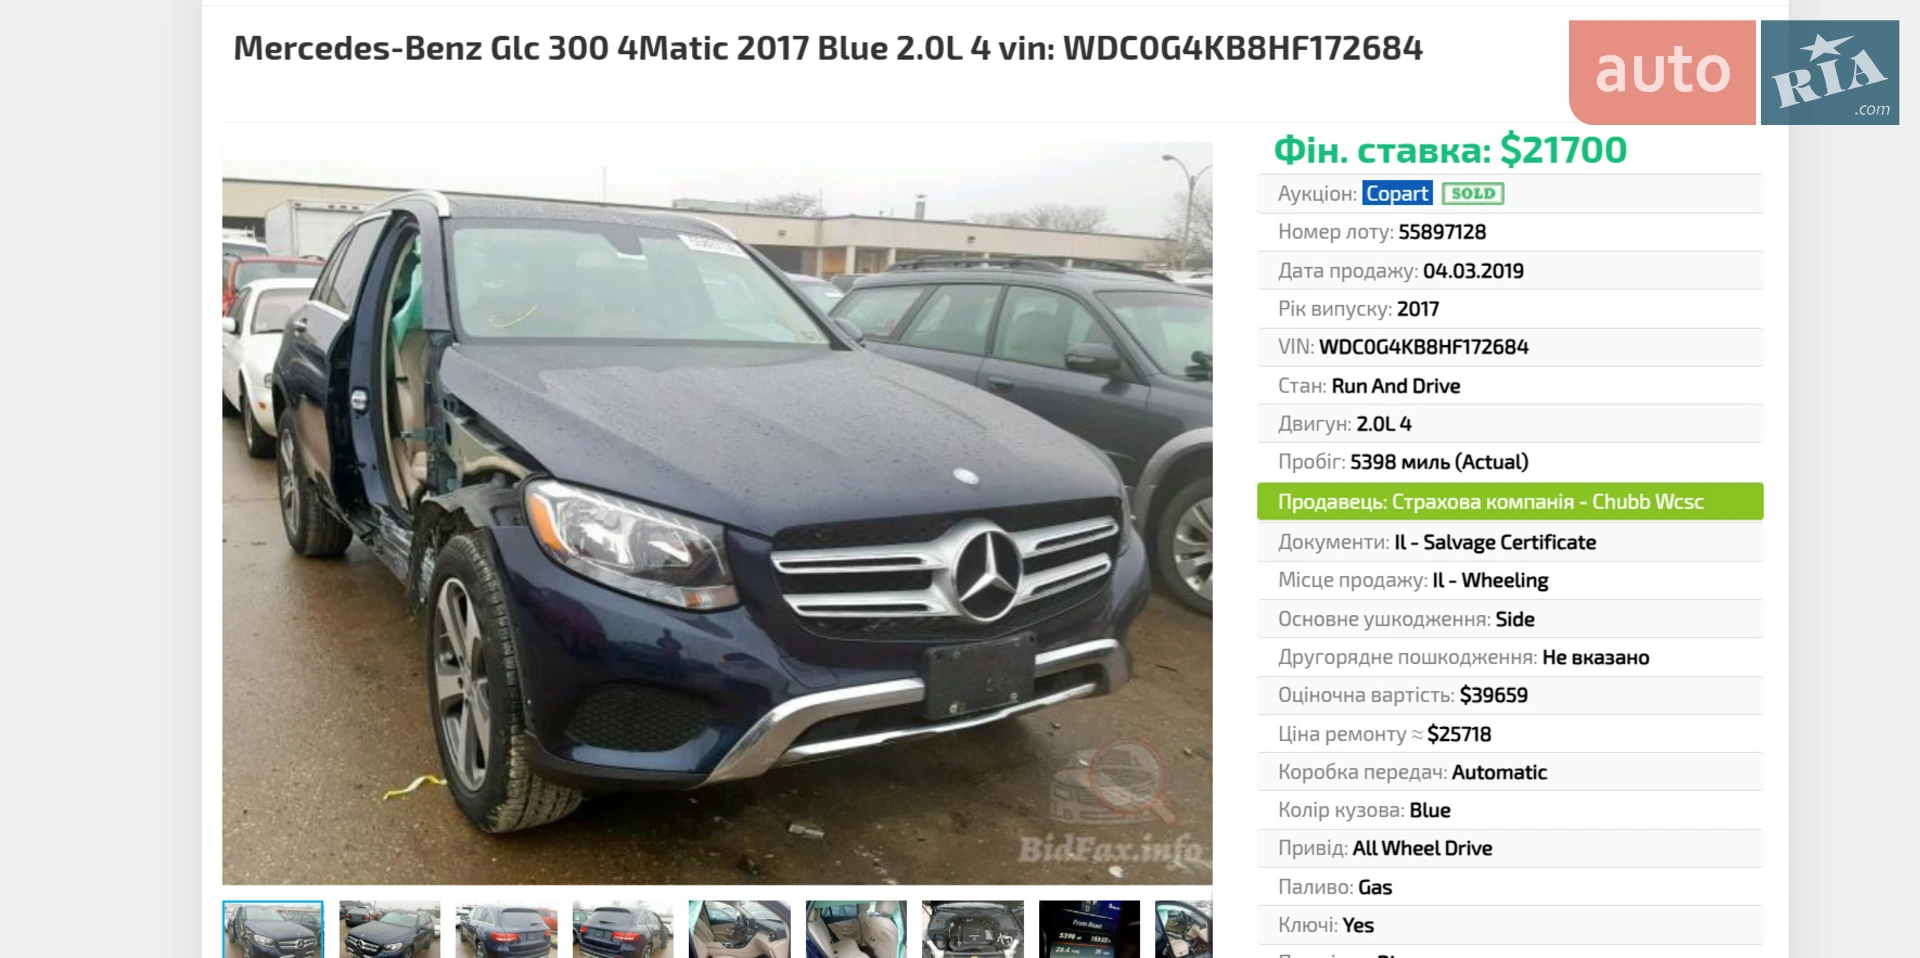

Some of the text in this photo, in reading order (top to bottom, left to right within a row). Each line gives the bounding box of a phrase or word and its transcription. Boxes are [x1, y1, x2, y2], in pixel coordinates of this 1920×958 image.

[235, 35, 1423, 60] Mercedes-Benz Glc 300 4Matic 2017 Blue 2.0L 4 vin: WDC0G4KB8HF172684
[1274, 130, 1627, 169] Фін. ставка: $21700
[1279, 184, 1496, 206] Аукціон: Copart SOLD
[1280, 223, 1486, 243] Номер лоту: 55897128
[1279, 262, 1524, 282] Дата продажу: 04.03.2019
[1280, 300, 1440, 320] Рік випуску: 2017
[1279, 338, 1529, 355] VIN: WDC0G4KB8HF172684
[1279, 377, 1461, 394] Стан: Run And Drive
[1279, 415, 1412, 435] Двигун: 2.0L 4
[1280, 452, 1529, 473] Пробіг: 5398 миль (Actual)
[1279, 493, 1387, 513] Продавець:
[1392, 493, 1481, 514] Страхова
[1487, 493, 1574, 509] компанія
[1592, 493, 1651, 509] Chubb
[1655, 493, 1704, 509] Wcsc
[1279, 534, 1389, 554] Документи:
[1424, 534, 1496, 554] Salvage
[1501, 534, 1596, 550] Certificate
[1280, 572, 1334, 590] Місце
[1340, 576, 1427, 592] продажу:
[1461, 572, 1549, 592] Wheeling
[1279, 611, 1535, 631] Основне ушкодження: Side
[1279, 649, 1650, 669] Другорядне пошкодження: Не вказано
[1279, 684, 1528, 706] Оціночна вартість: $39659
[1280, 726, 1319, 744] Ціна
[1326, 730, 1407, 746] ремонту
[1427, 723, 1492, 745] $25718
[1280, 763, 1548, 783] Коробка передач: Automatic
[1280, 802, 1451, 822] Колір кузова: Blue
[1280, 840, 1493, 859] Привід: All Wheel Drive
[1280, 879, 1393, 895] Паливо: Gas
[1280, 917, 1374, 933] Ключі: Yes
